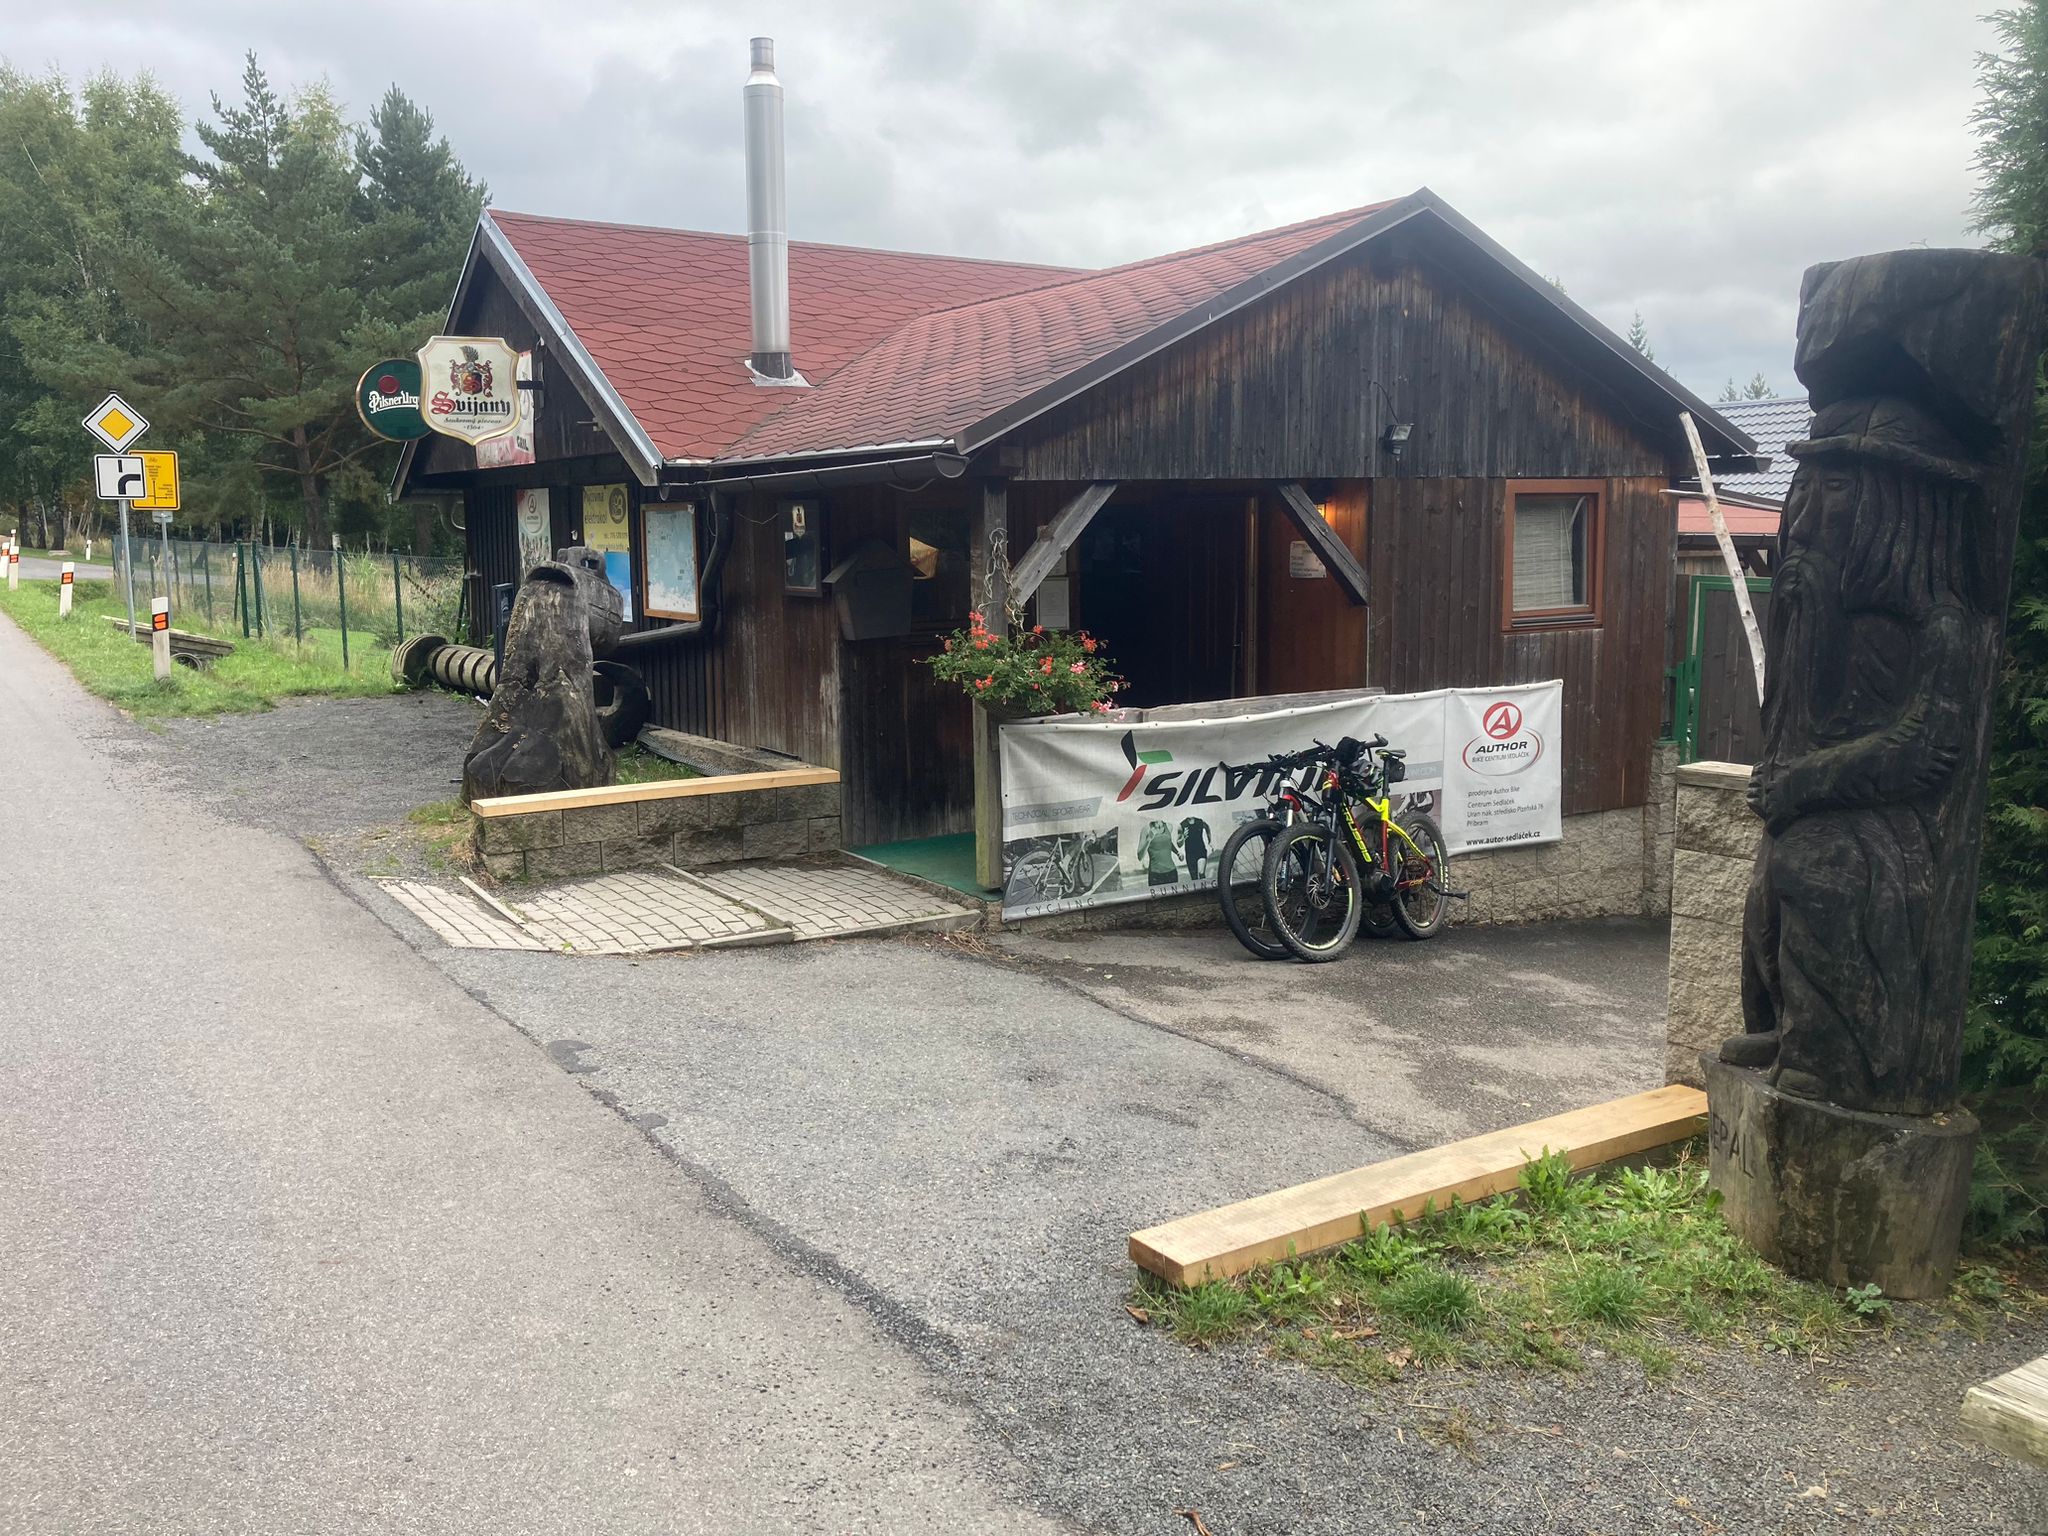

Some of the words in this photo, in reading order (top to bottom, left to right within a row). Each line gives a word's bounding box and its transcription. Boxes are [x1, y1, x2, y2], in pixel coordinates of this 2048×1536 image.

[431, 391, 511, 416] Svijany
[1475, 741, 1528, 754] AUTHOR
[1485, 754, 1507, 762] CENTRUM
[1011, 807, 1049, 821] TECHNICAL
[1051, 804, 1092, 817] SPORTWEAR
[1467, 801, 1492, 809] Centrum
[1149, 880, 1219, 899] RUNNING
[1024, 898, 1096, 917] CYCLING
